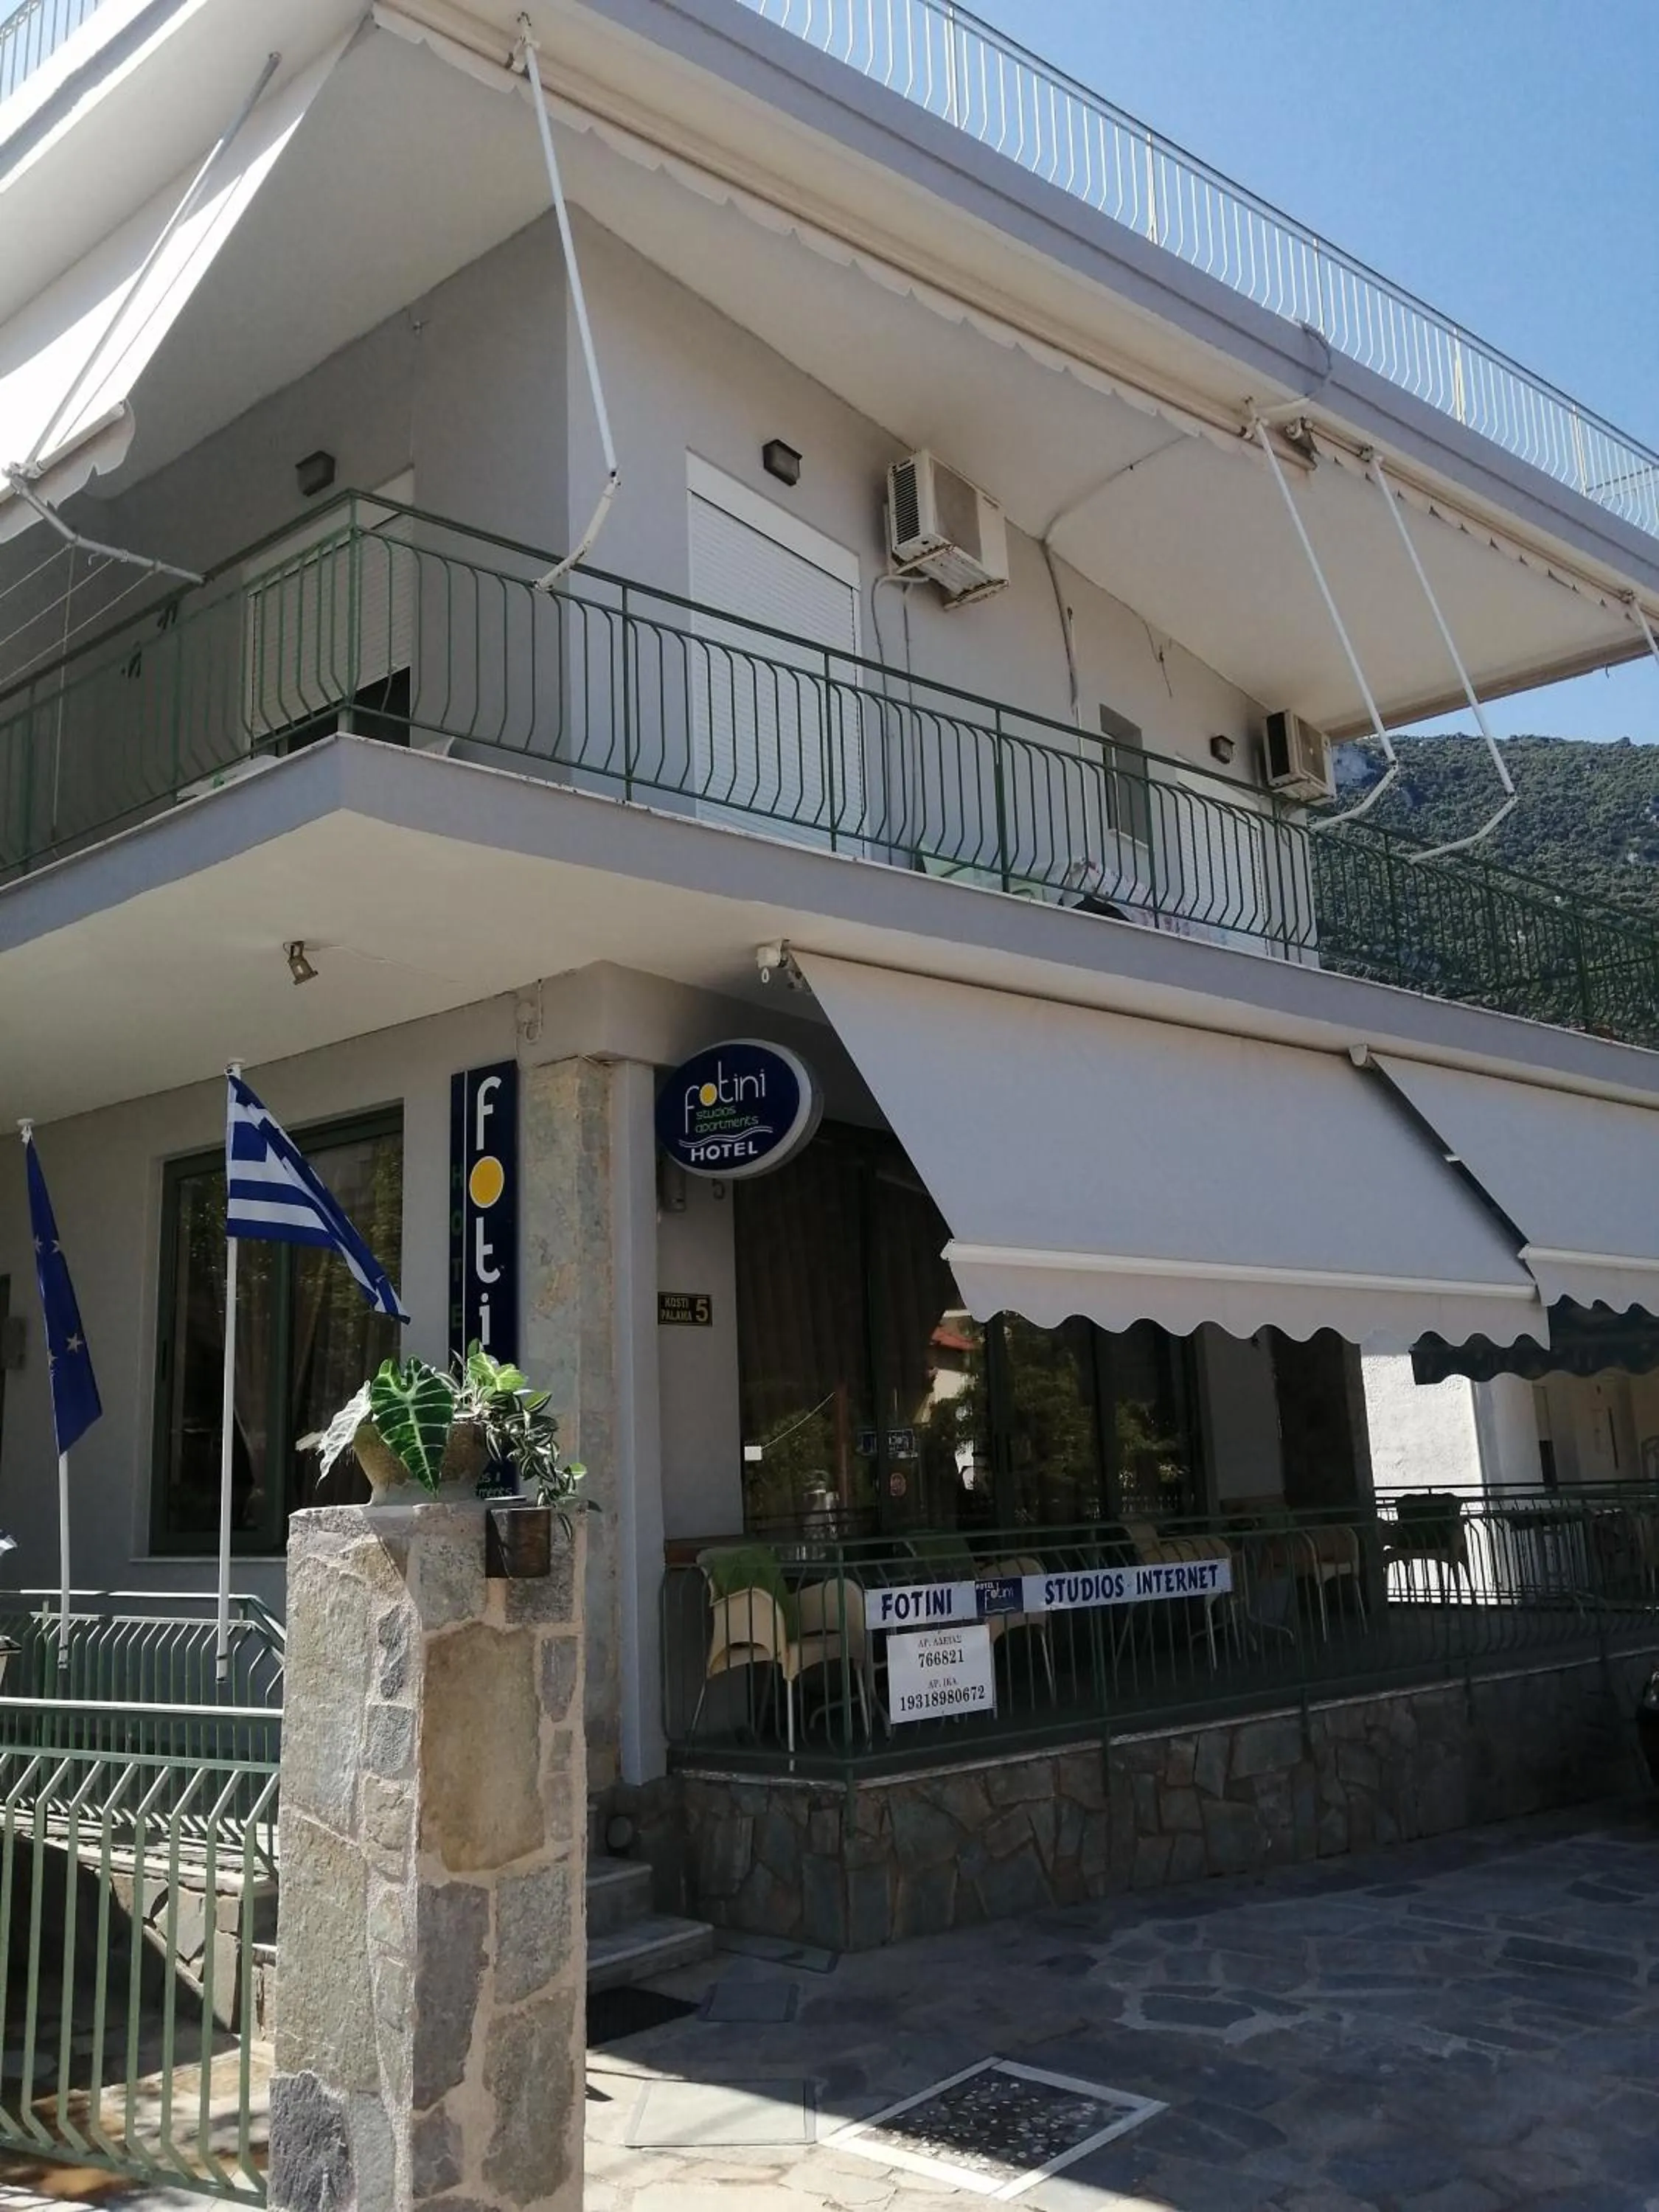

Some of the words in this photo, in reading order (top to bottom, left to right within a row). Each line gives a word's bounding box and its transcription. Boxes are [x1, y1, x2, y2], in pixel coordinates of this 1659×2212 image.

[685, 1060, 766, 1135] fotini
[695, 1116, 759, 1134] apartments
[696, 1106, 737, 1120] studios
[691, 1141, 759, 1162] HOTEL
[469, 1075, 505, 1346] foti
[451, 1164, 464, 1329] HOTE
[695, 1298, 709, 1322] 5
[1044, 1574, 1124, 1605] STUDIOS
[1136, 1564, 1219, 1595] INTERNET
[881, 1587, 953, 1621] FOTINI
[918, 1649, 964, 1668] 766821
[900, 1685, 985, 1711] 19318980672
